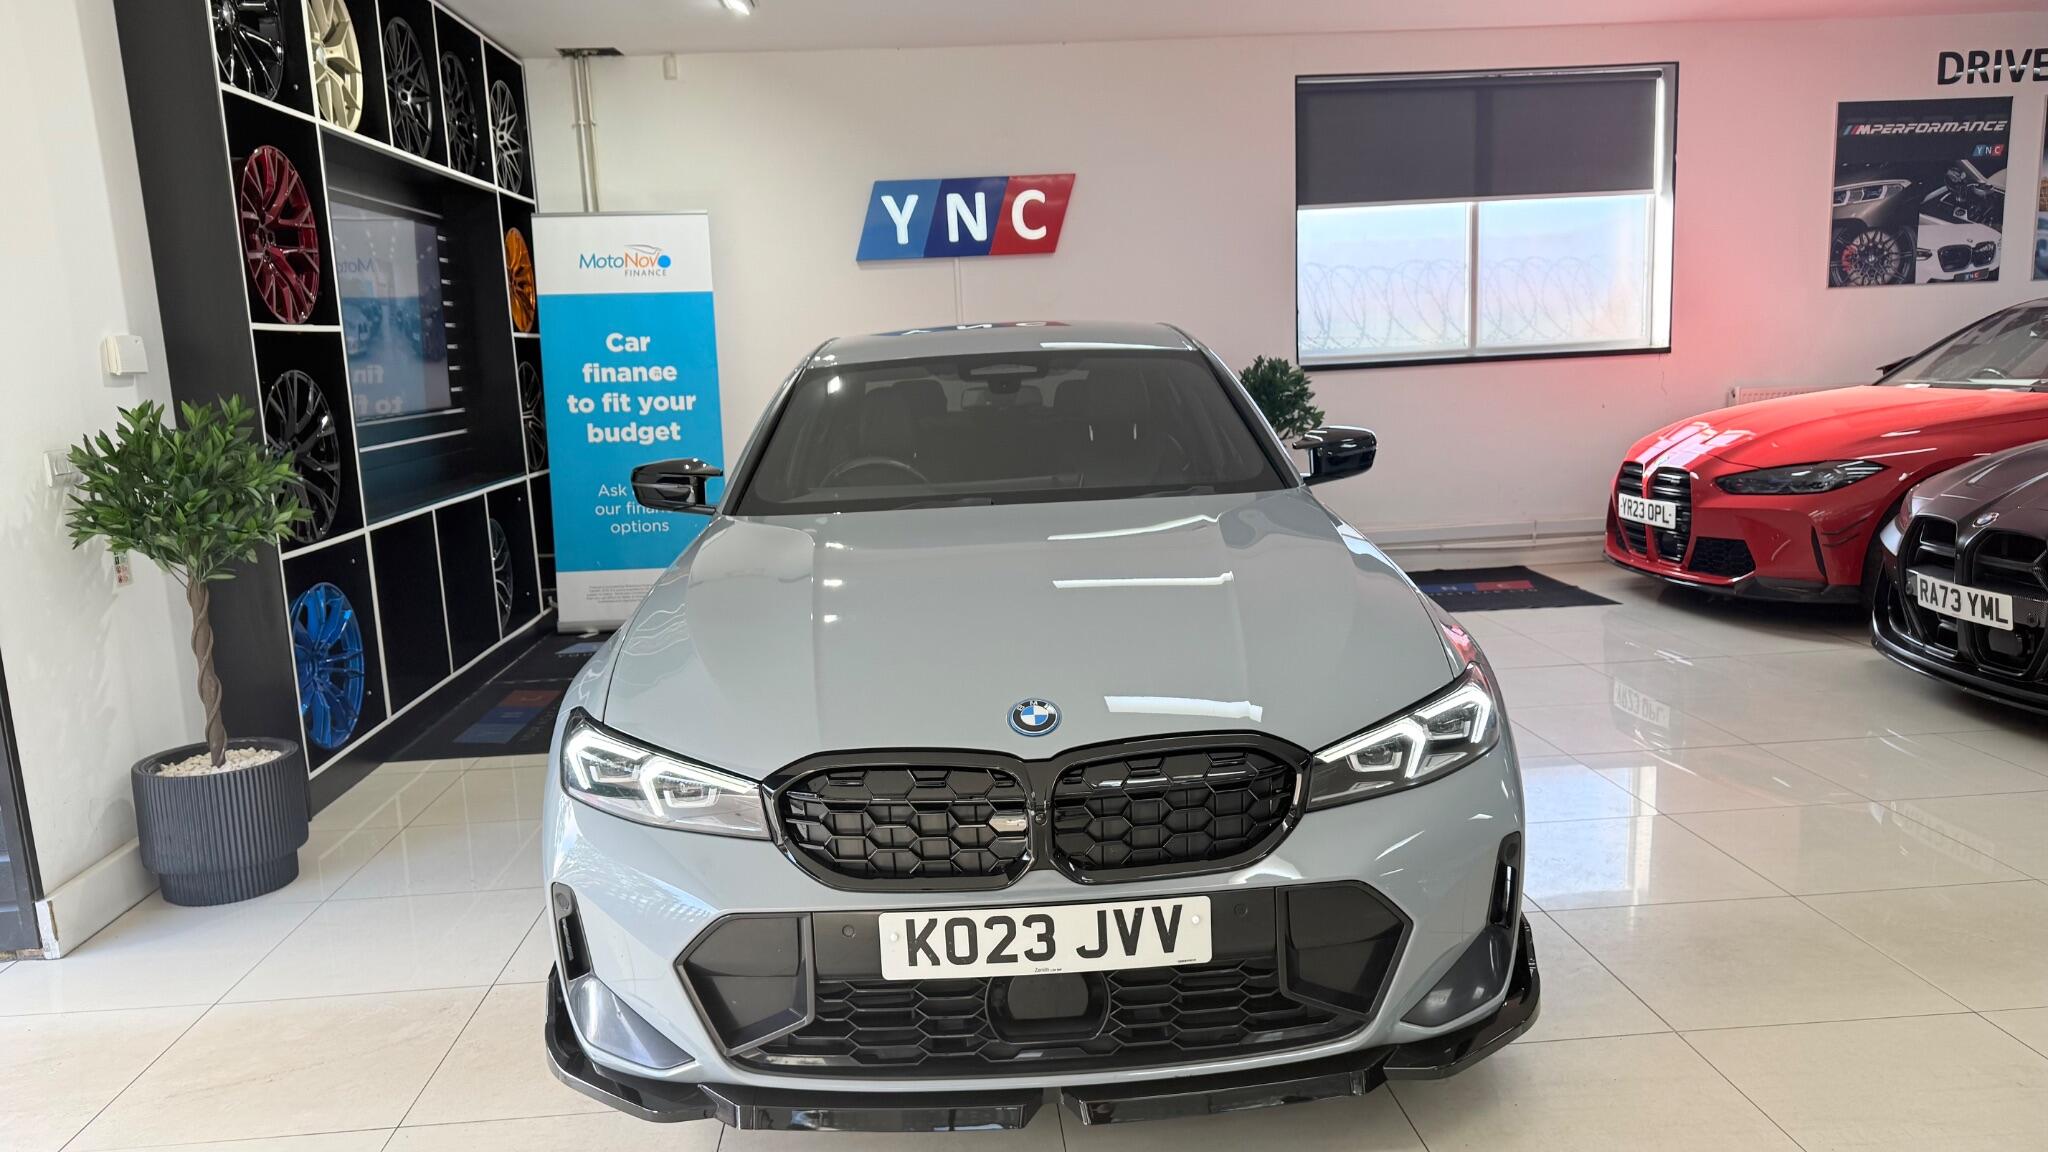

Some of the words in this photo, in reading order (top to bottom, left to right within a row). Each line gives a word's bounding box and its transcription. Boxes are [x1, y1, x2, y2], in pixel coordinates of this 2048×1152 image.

[1937, 48, 2048, 85] DRIVE
[1976, 145, 2001, 155] YNC
[881, 189, 1047, 245] YNC
[579, 252, 672, 269] MotoNovo
[624, 269, 667, 277] FINANCE
[605, 332, 651, 353] Car
[582, 362, 678, 383] finance
[566, 394, 595, 414] to
[601, 392, 631, 413] fit
[637, 394, 697, 416] your
[586, 421, 682, 445] budget
[598, 483, 627, 497] Ask
[595, 504, 621, 516] our
[626, 501, 672, 515] fina
[1622, 497, 1645, 519] YR23
[1647, 503, 1670, 524] OPL
[610, 520, 670, 536] options
[1920, 578, 1961, 613] RA73
[1967, 591, 2009, 624] YML
[905, 913, 1056, 967] KO23
[1076, 904, 1183, 960] JVV
